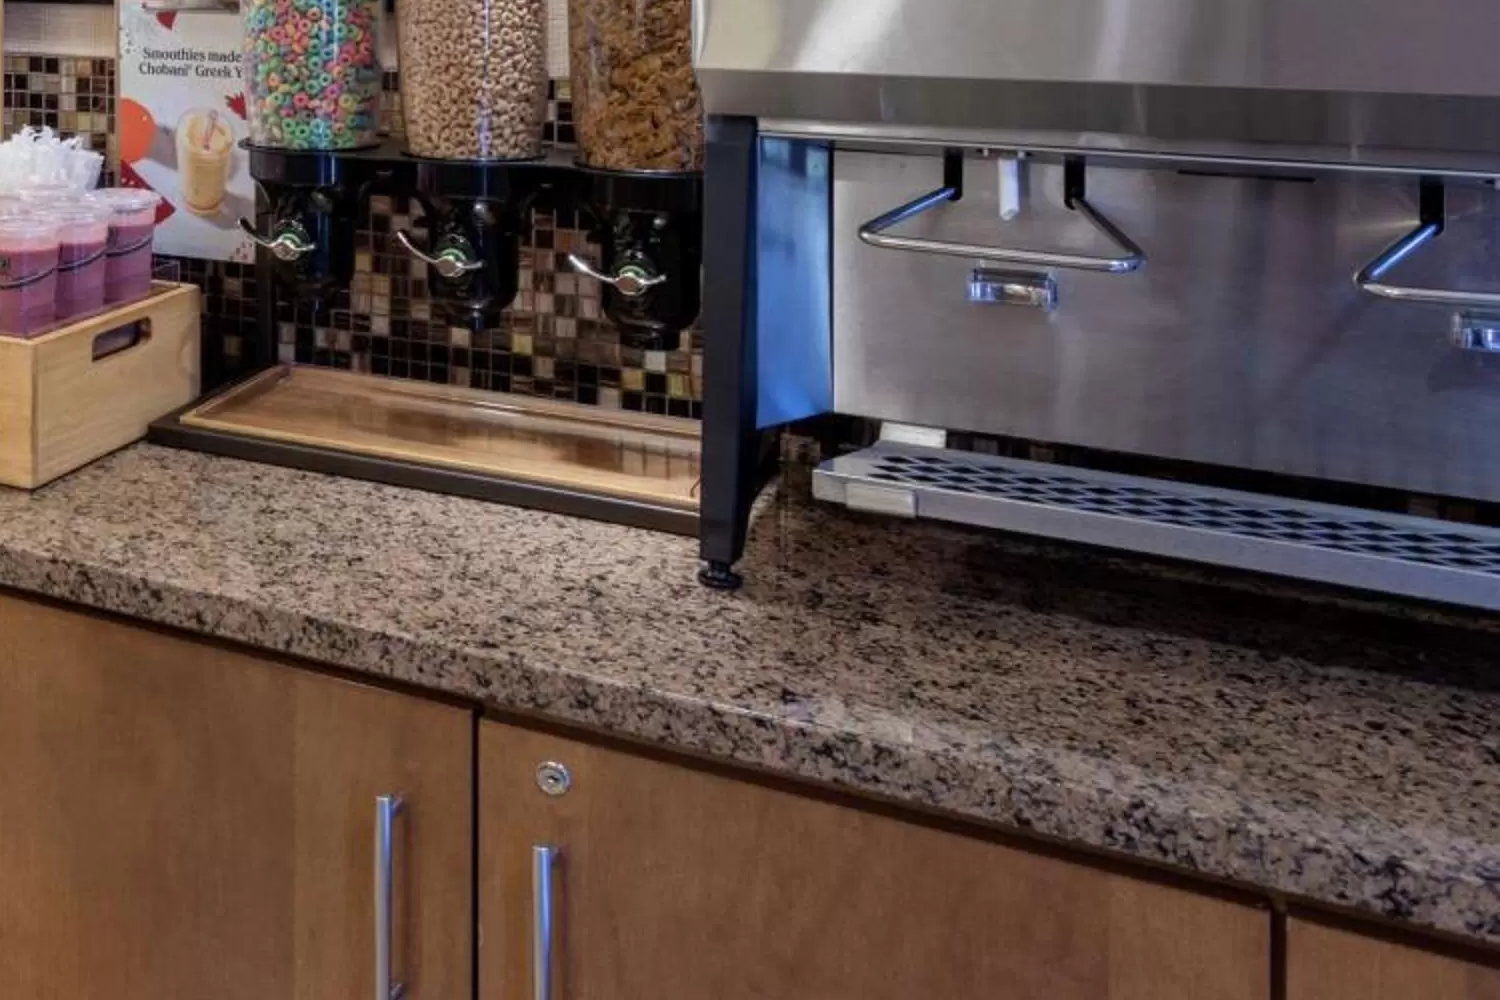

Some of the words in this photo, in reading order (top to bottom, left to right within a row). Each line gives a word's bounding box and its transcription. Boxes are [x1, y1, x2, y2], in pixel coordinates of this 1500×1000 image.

[143, 46, 206, 61] Smoothies
[208, 50, 242, 62] made
[195, 64, 232, 78] Greek
